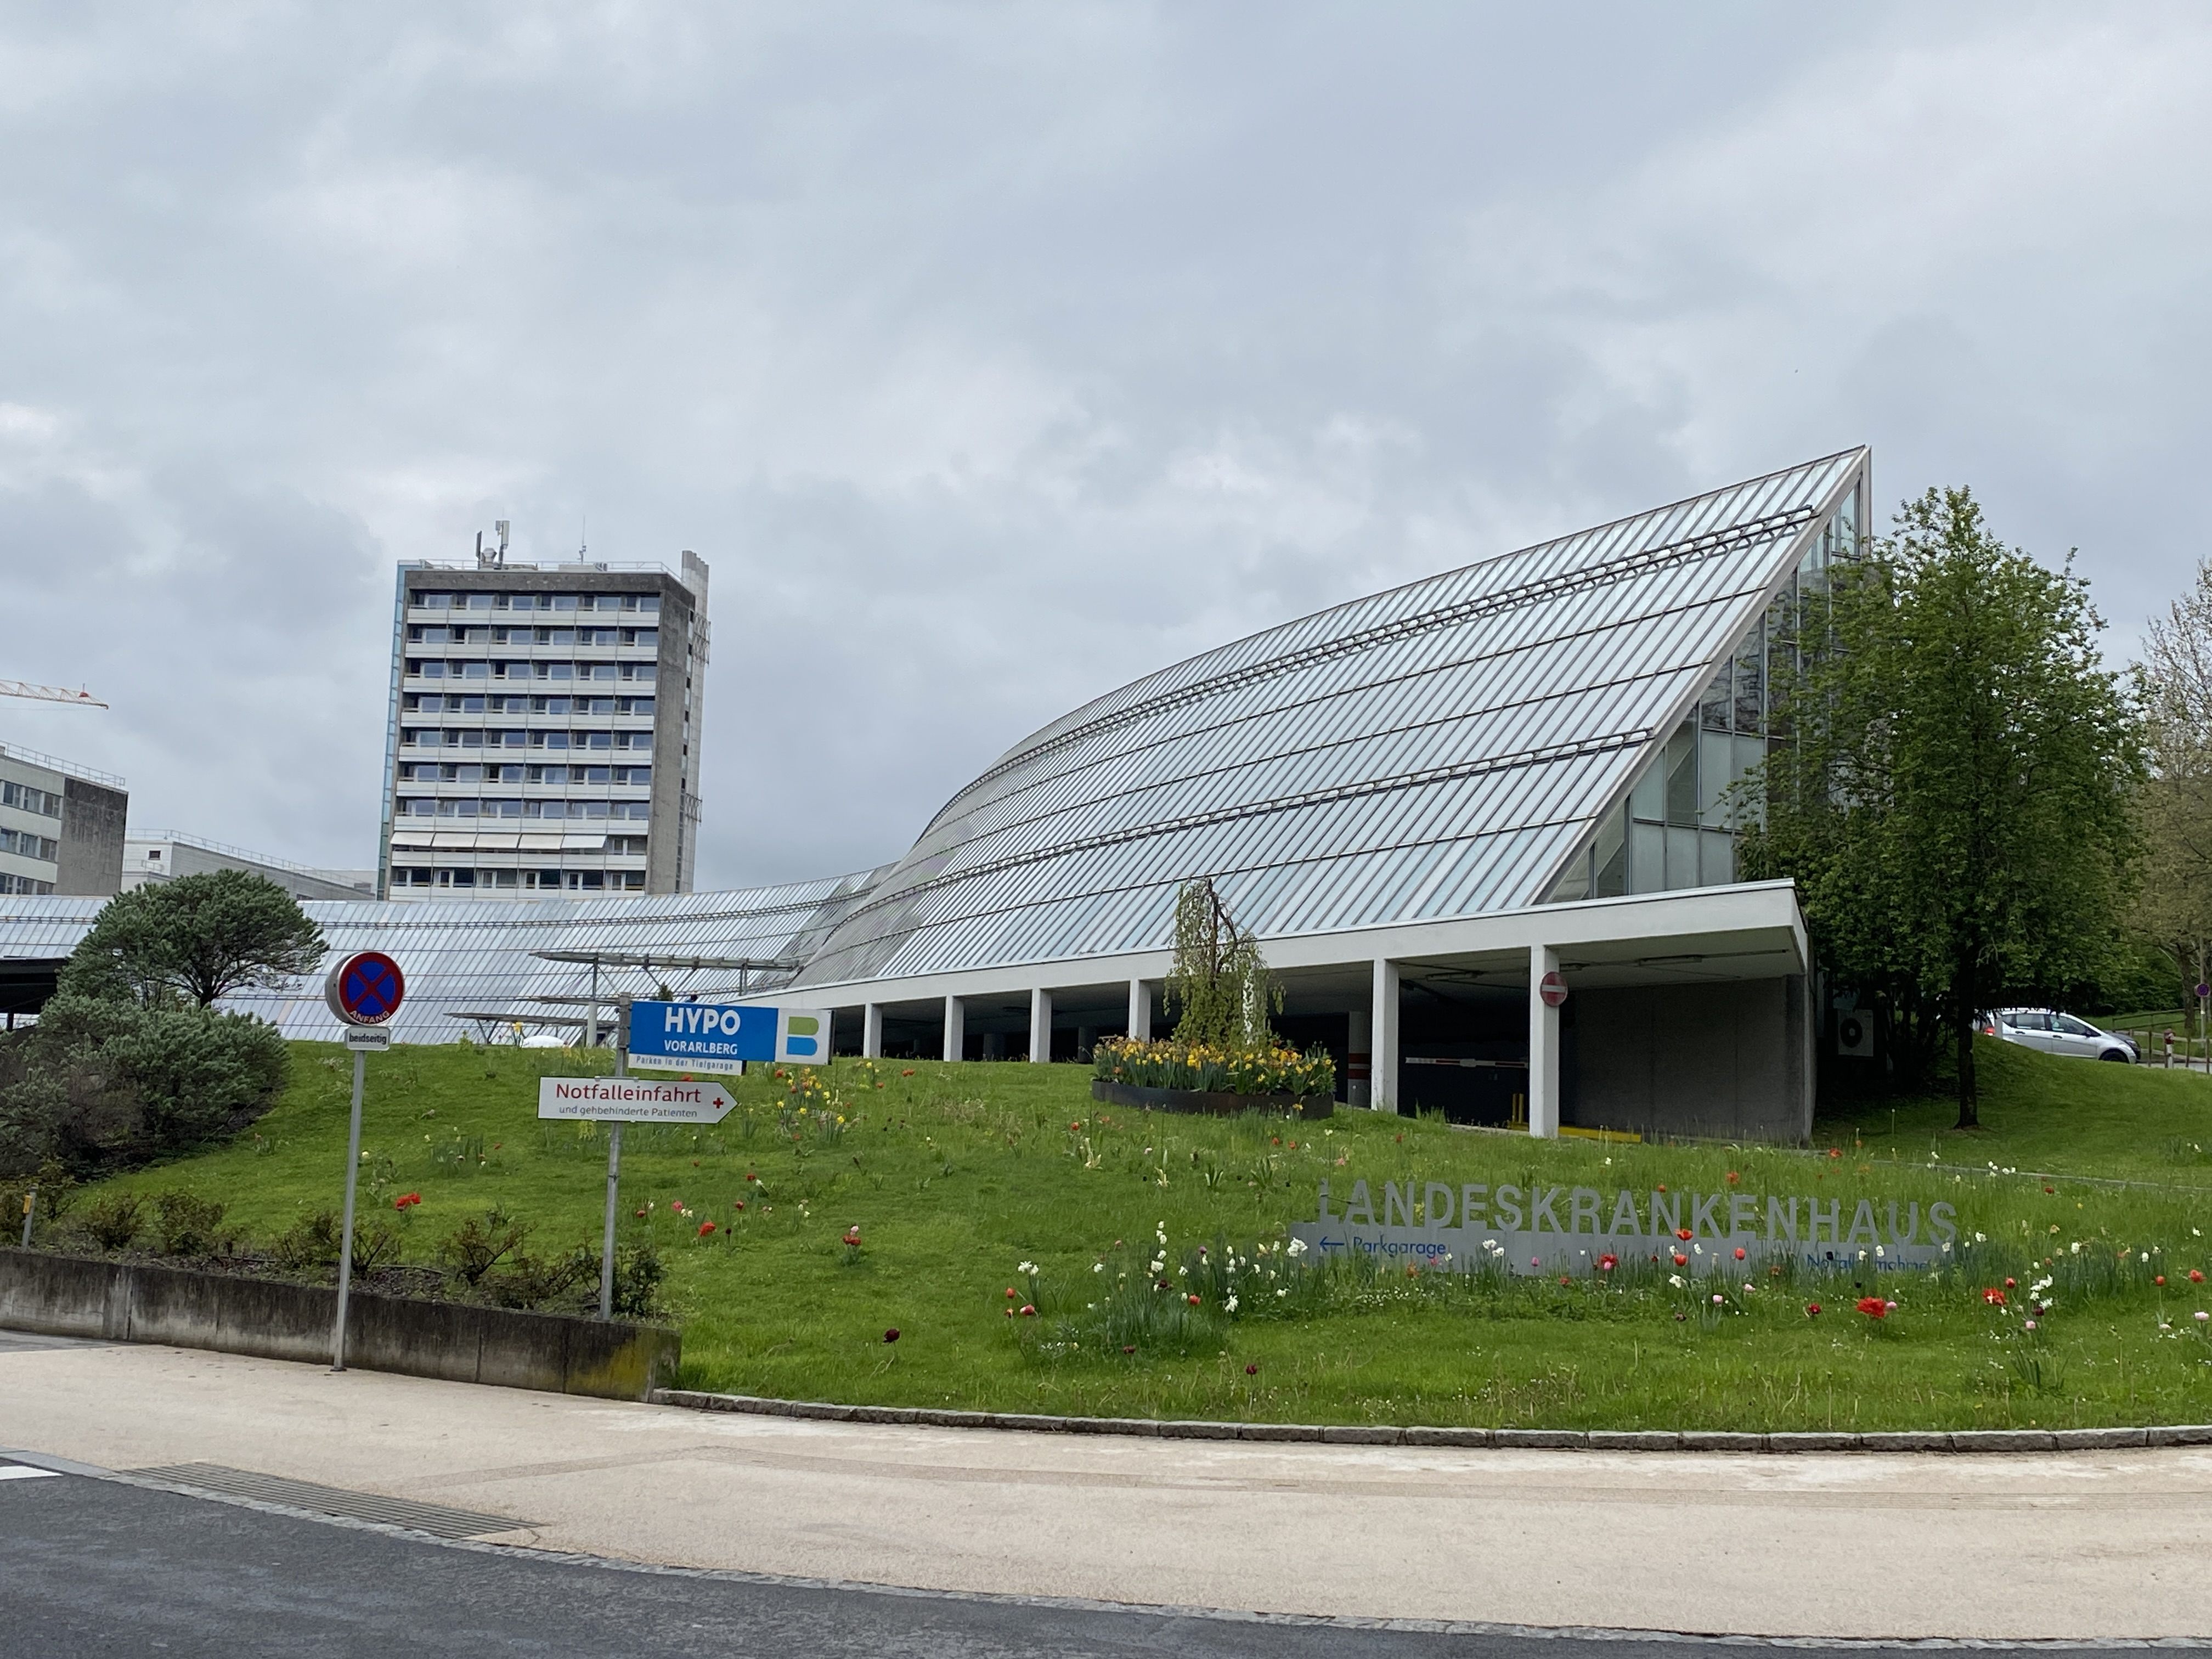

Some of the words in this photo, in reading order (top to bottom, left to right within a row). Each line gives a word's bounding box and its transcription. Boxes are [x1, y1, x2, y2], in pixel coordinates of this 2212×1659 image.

[349, 1009, 390, 1023] ANFANG
[664, 1006, 741, 1036] HYPO
[348, 1033, 387, 1045] beidseitig
[664, 1040, 738, 1055] VORARLBERG
[636, 1055, 662, 1065] Parken
[675, 1058, 689, 1066] der
[556, 1084, 702, 1103] Notfalleinfahrt
[559, 1105, 577, 1114] und
[579, 1105, 650, 1116] gehbehinderte
[651, 1108, 698, 1118] Patienten
[1318, 1178, 1956, 1245] LANDESKRANKENHAUS
[1353, 1234, 1447, 1259] Parkgarage
